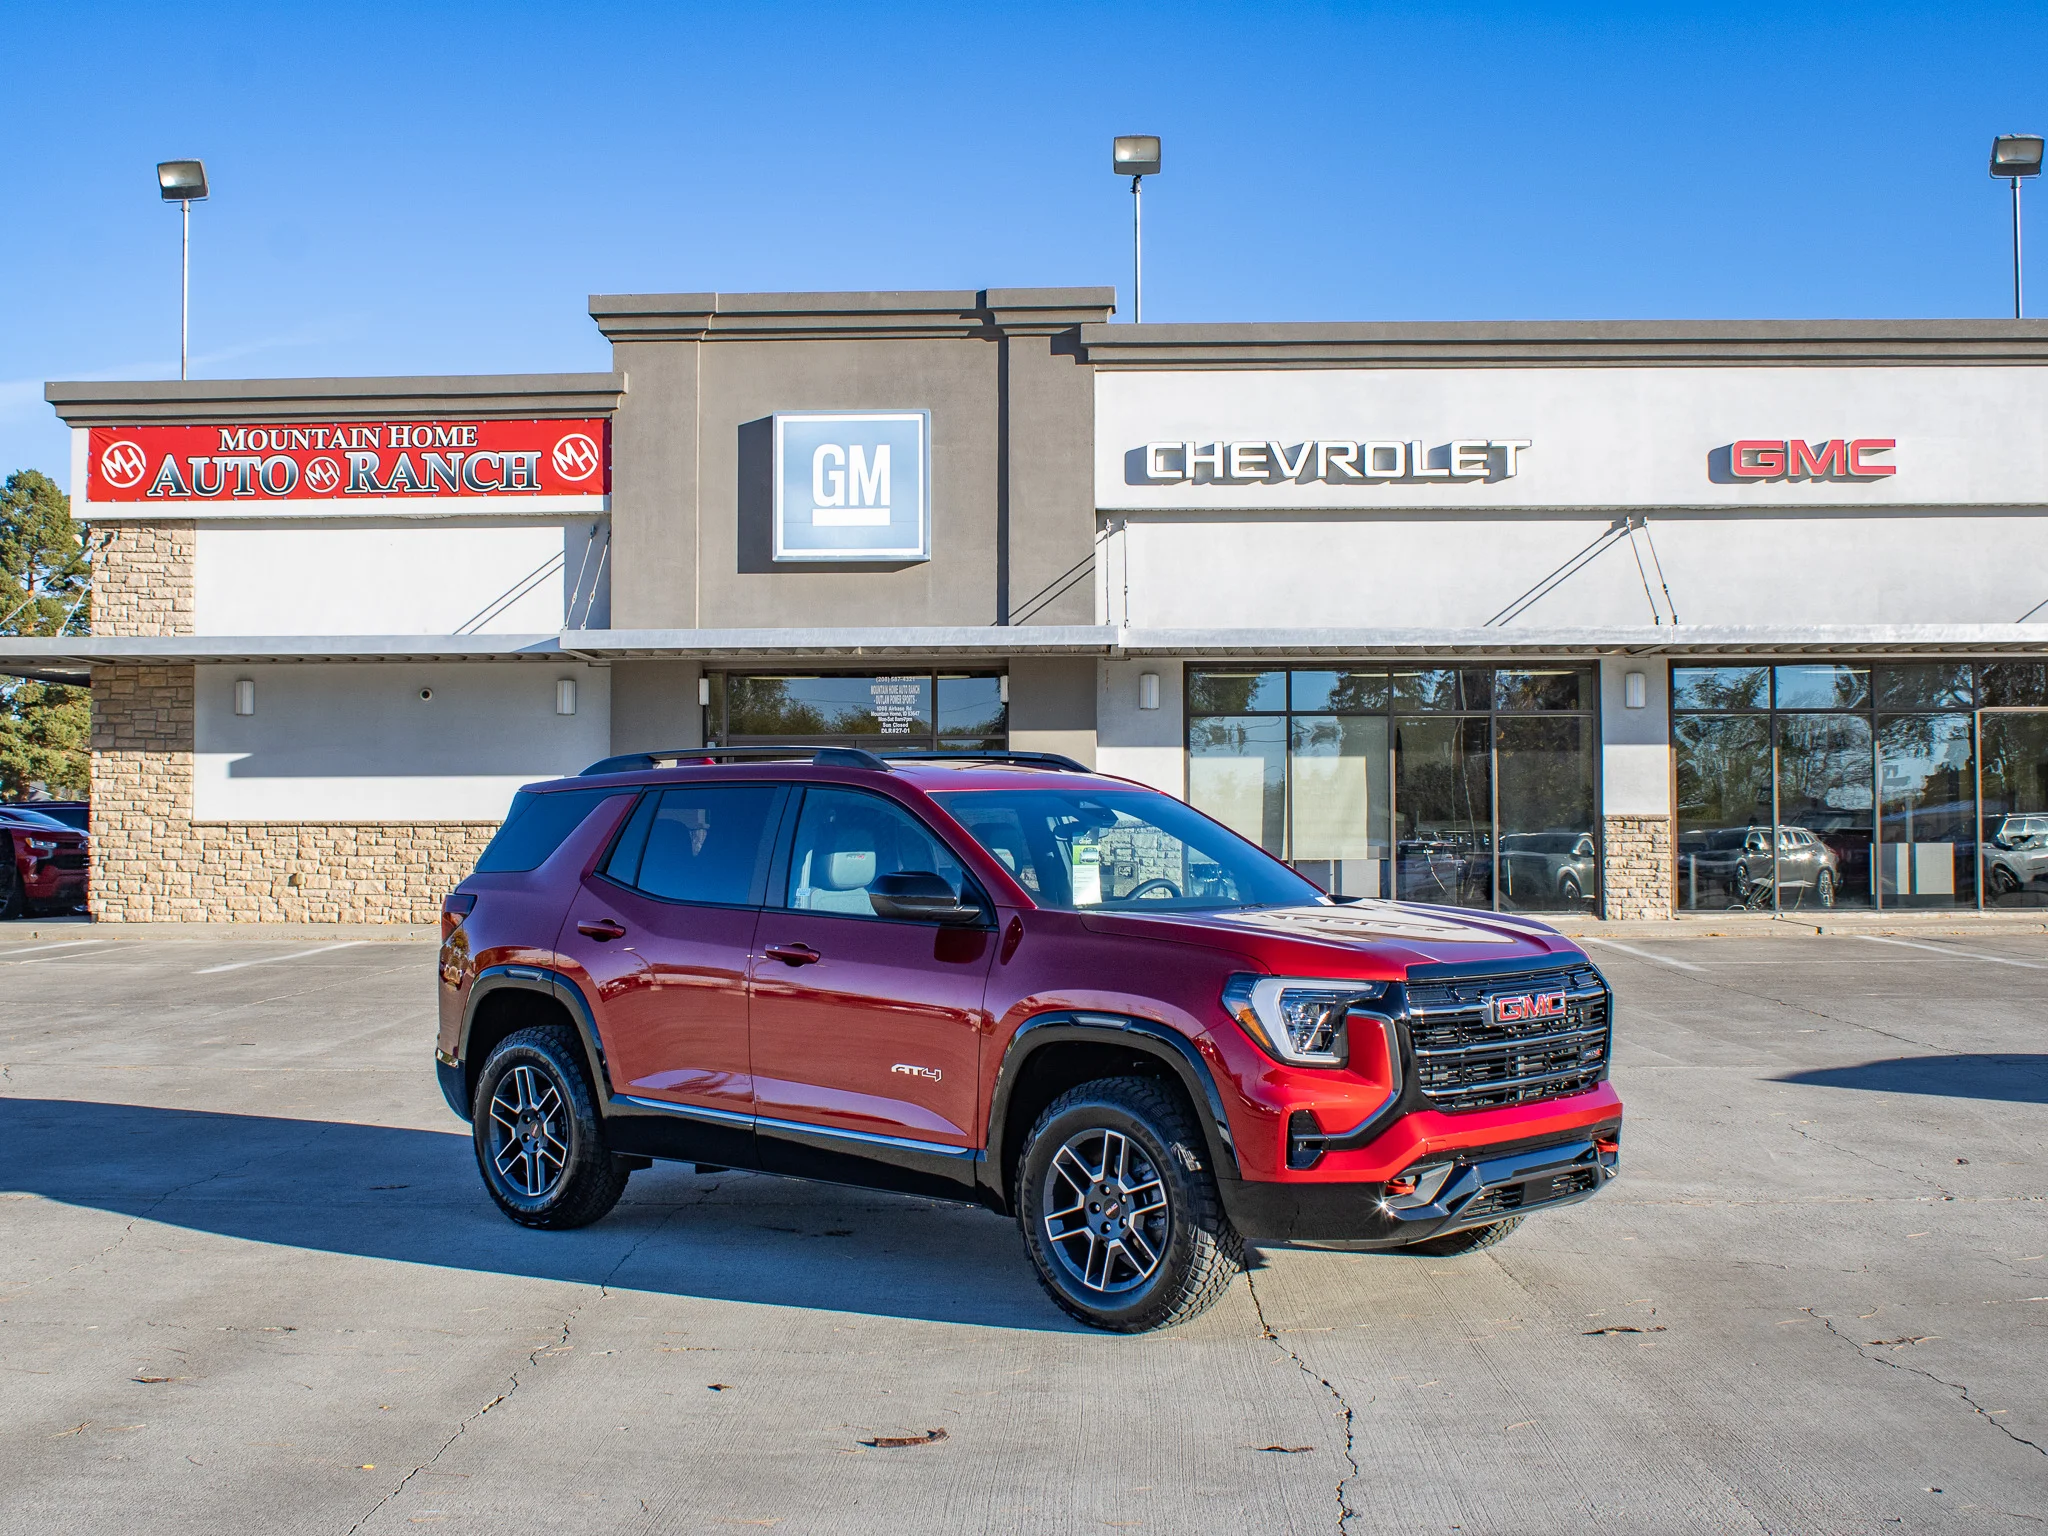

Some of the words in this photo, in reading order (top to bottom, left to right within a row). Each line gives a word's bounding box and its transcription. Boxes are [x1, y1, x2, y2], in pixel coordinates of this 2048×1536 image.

[218, 427, 380, 452] MOUNTAIN
[386, 425, 479, 448] HOME
[1731, 439, 1897, 477] GMC
[146, 453, 299, 497] AUTO
[344, 450, 542, 493] RANCH
[812, 443, 890, 507] GM
[1146, 439, 1532, 478] CHEVROLET
[1498, 992, 1566, 1021] GMC
[891, 1063, 942, 1082] AT4
[1023, 1174, 1057, 1282] GENERAL
